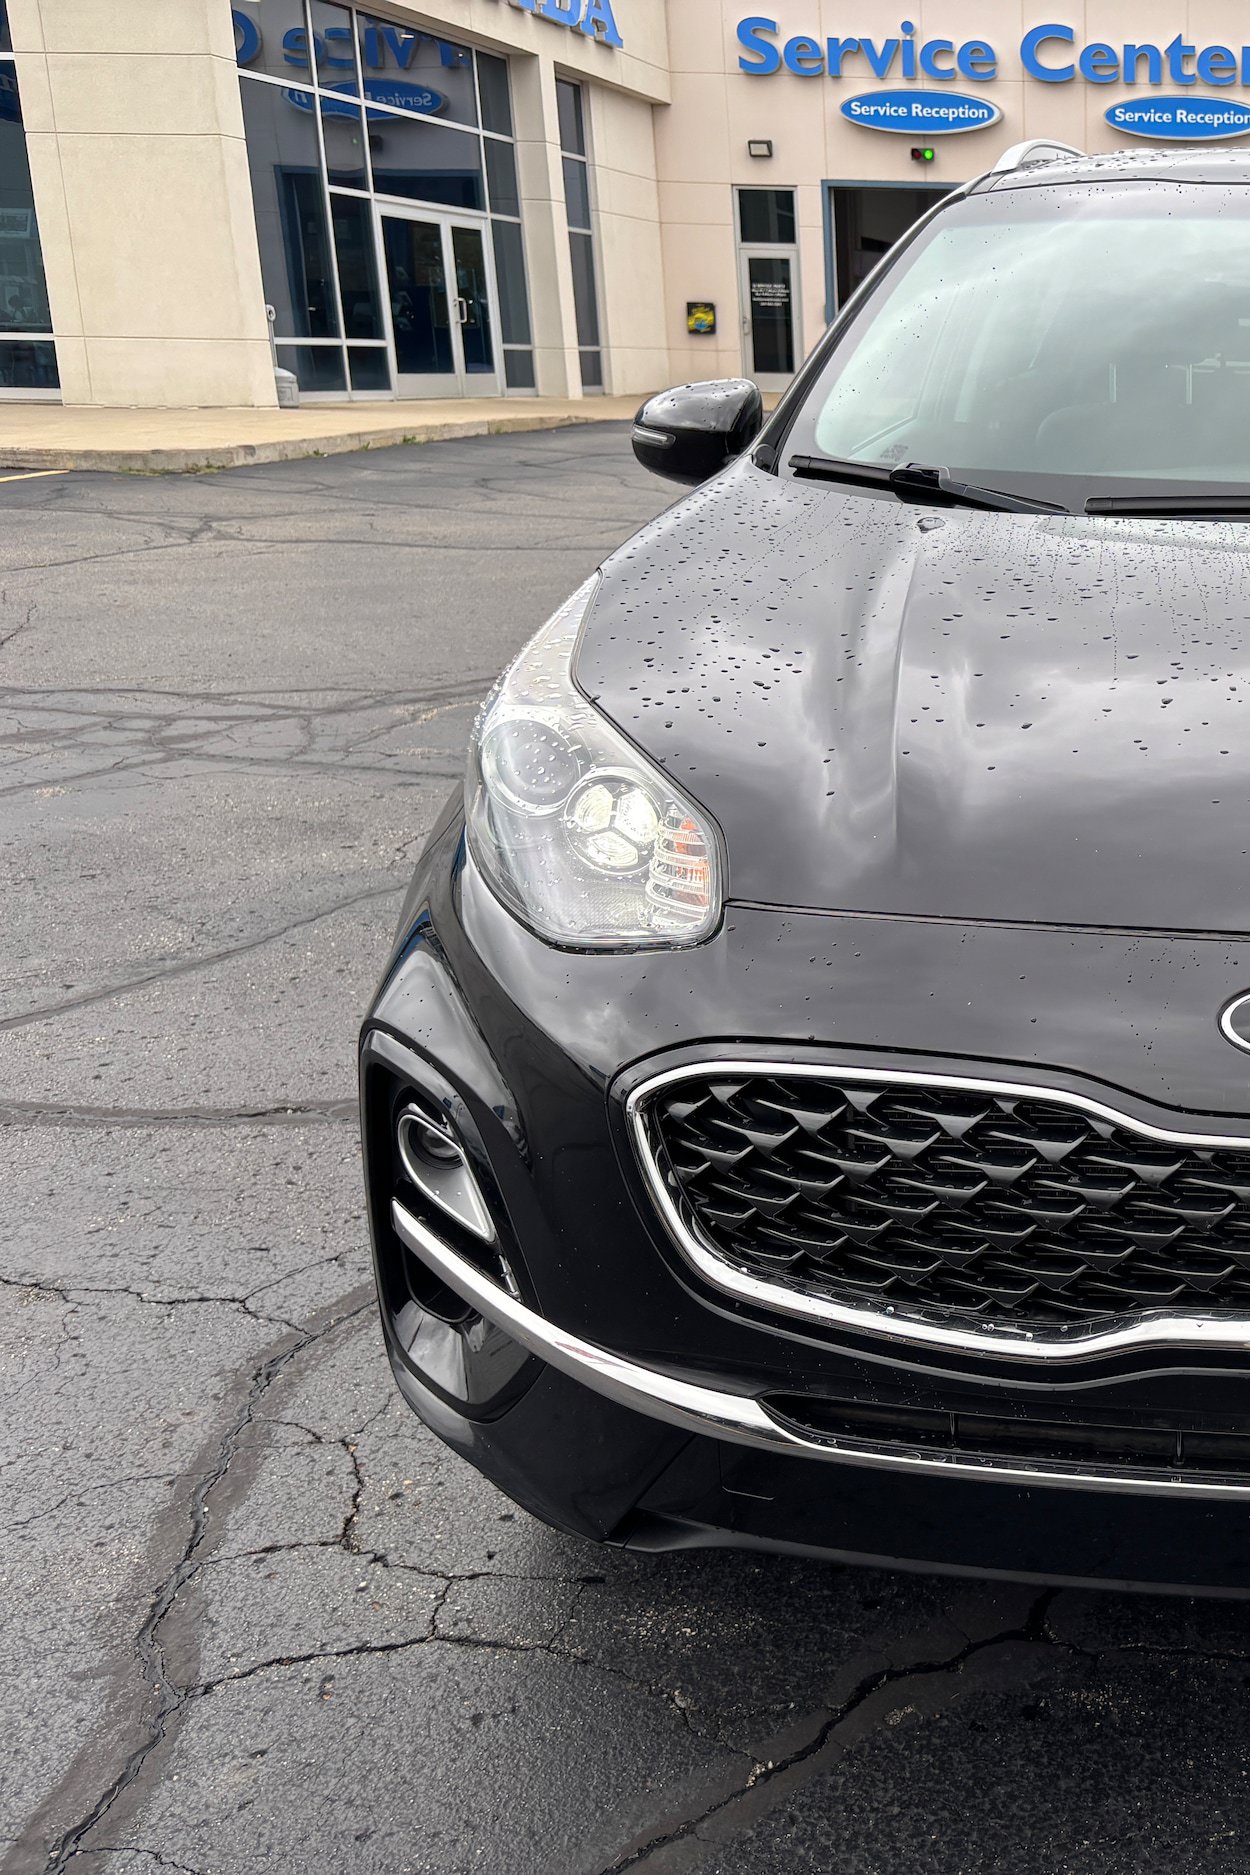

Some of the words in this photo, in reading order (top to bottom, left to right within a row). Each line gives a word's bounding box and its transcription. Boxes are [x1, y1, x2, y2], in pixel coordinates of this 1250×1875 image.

[735, 16, 998, 80] Service
[850, 101, 908, 118] Service
[912, 103, 989, 121] Reception
[1114, 107, 1172, 125] Service
